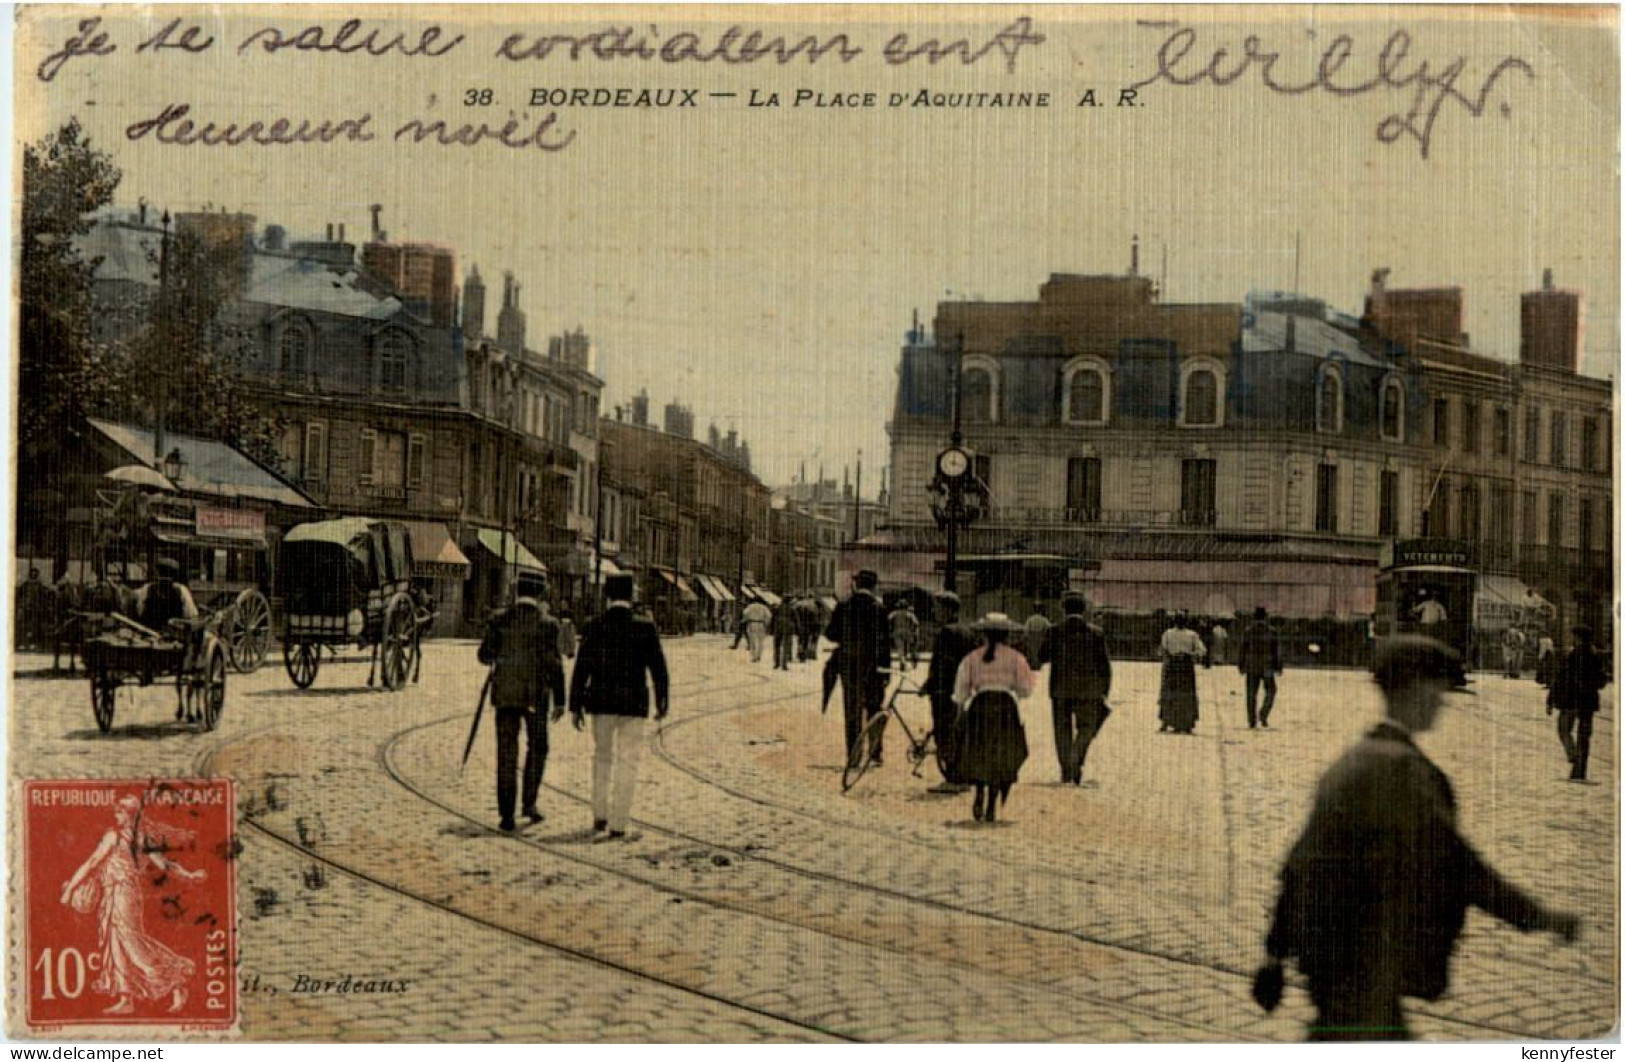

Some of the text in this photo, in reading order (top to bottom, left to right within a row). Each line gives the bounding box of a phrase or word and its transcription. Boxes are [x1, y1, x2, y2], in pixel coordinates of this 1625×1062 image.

[134, 17, 214, 55] te
[529, 88, 699, 107] BORDEAUX
[206, 929, 227, 1010] POSTES
[292, 973, 412, 994] Bordeaux
